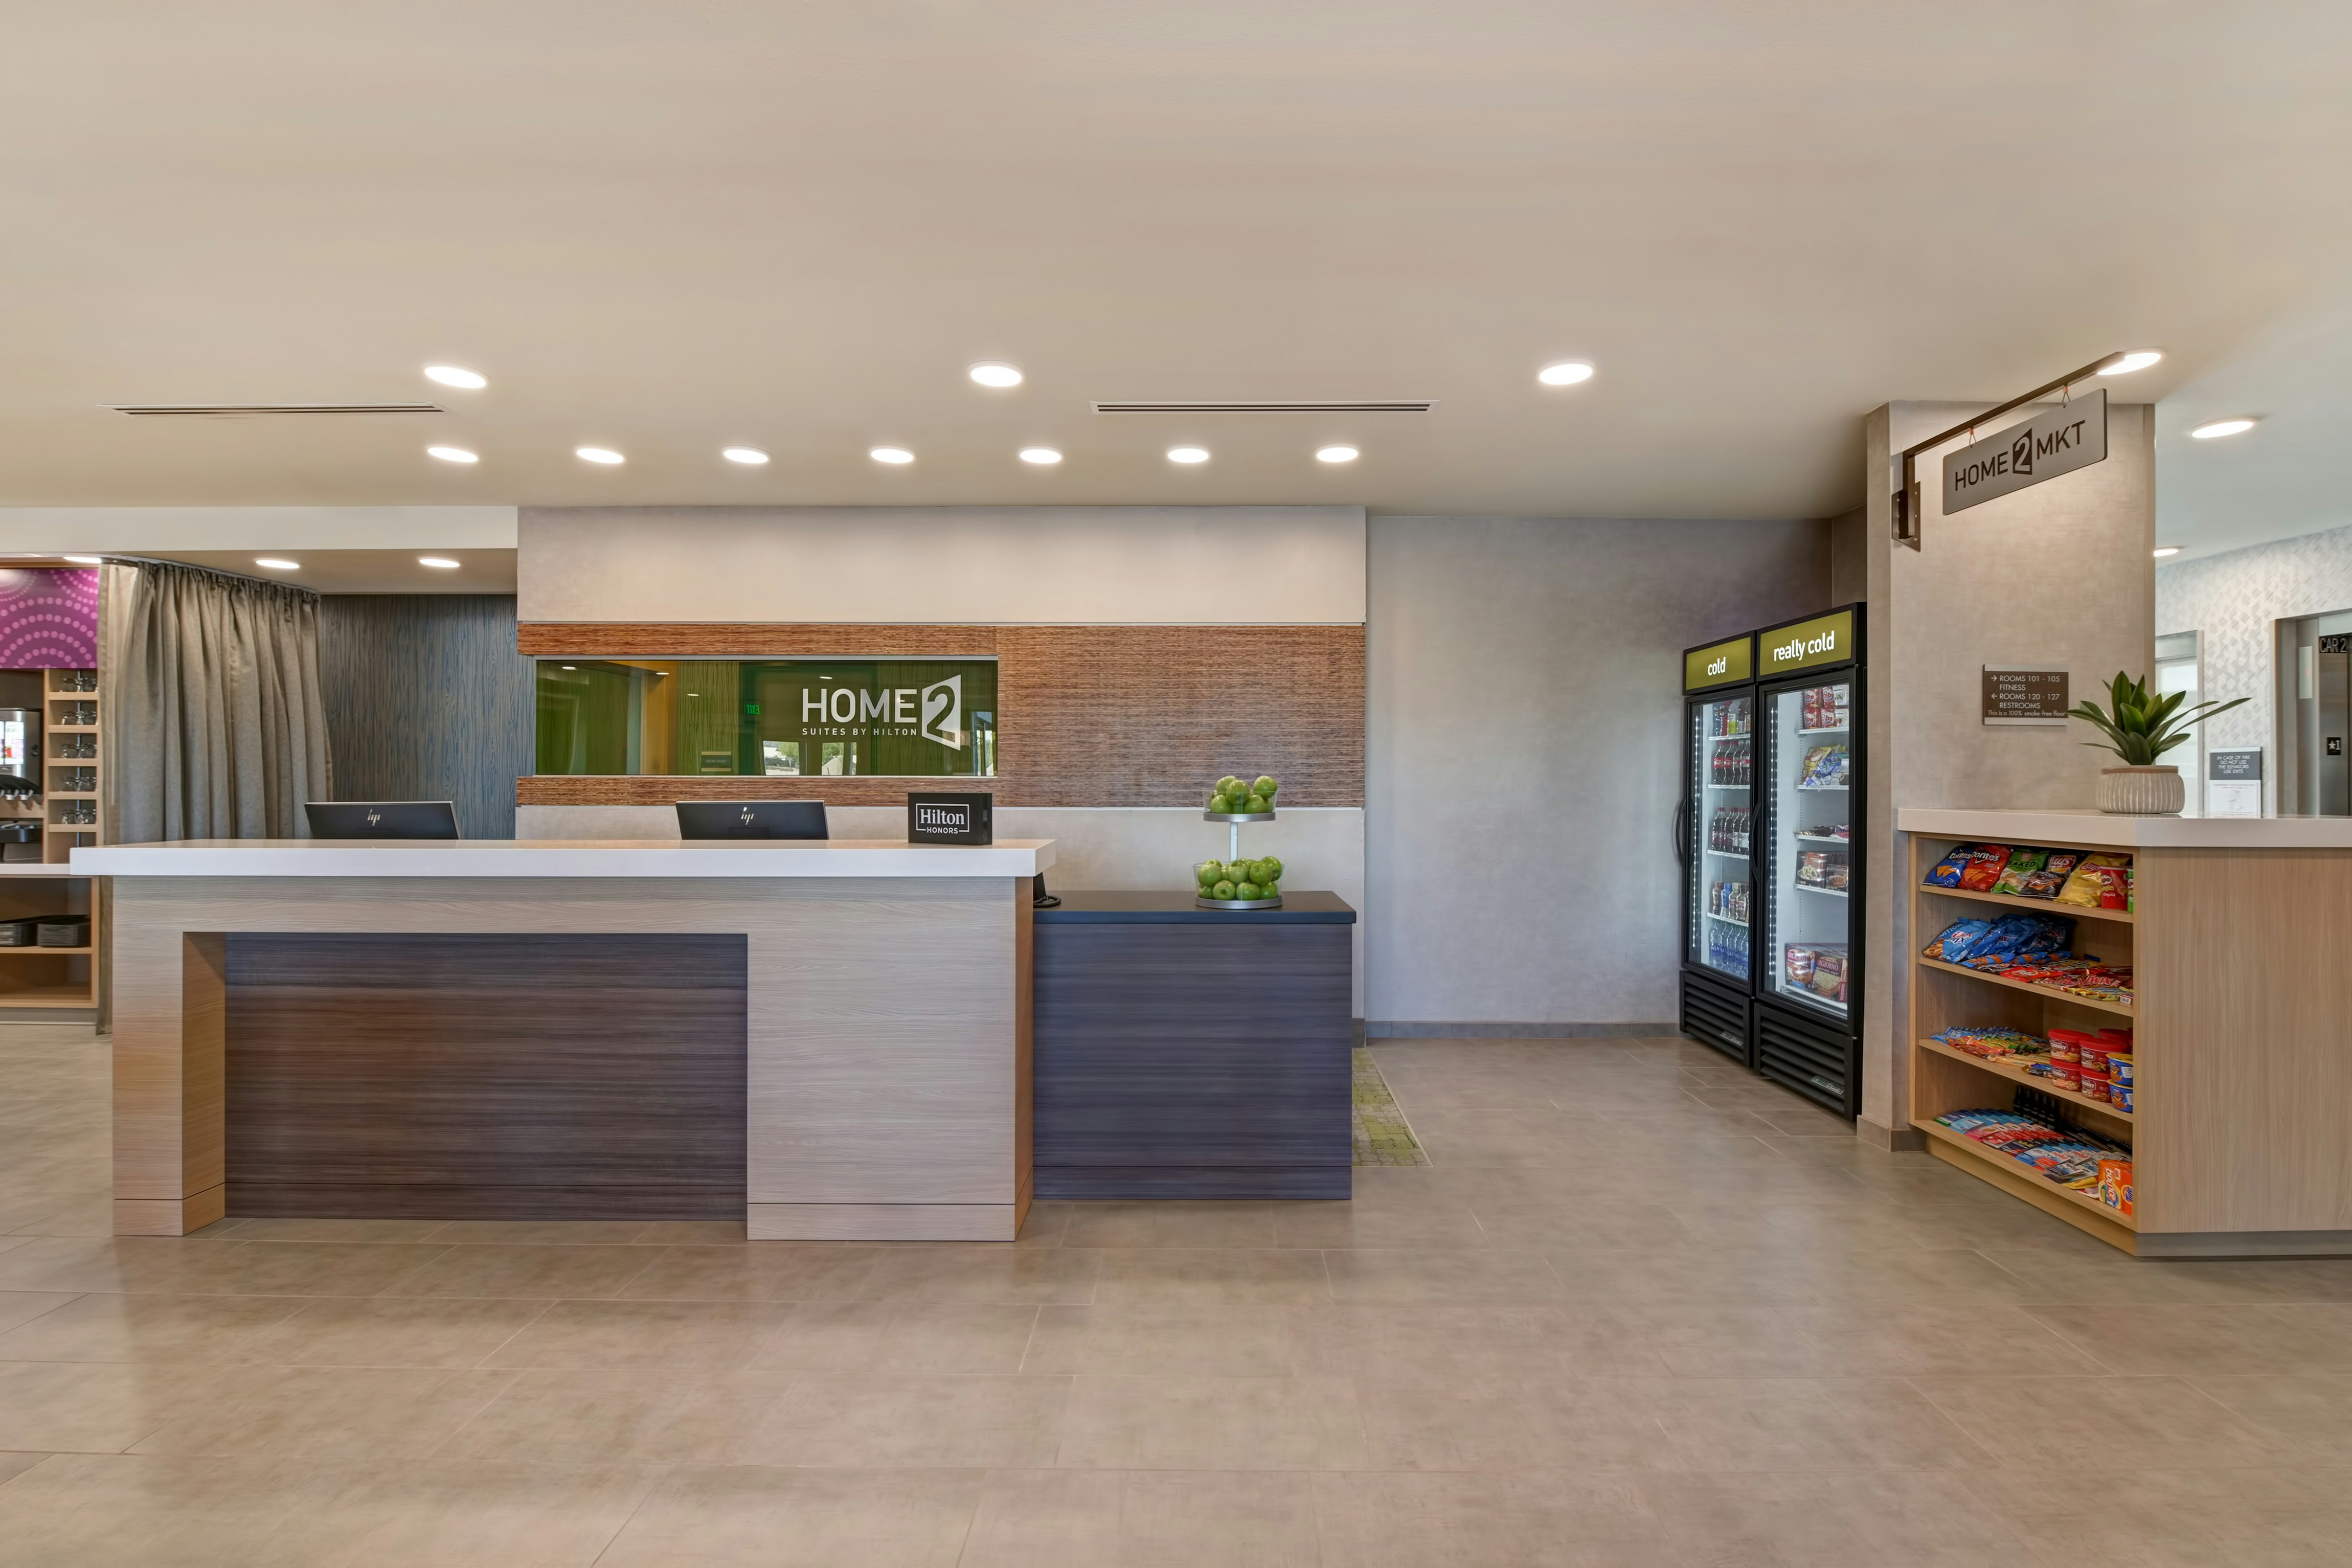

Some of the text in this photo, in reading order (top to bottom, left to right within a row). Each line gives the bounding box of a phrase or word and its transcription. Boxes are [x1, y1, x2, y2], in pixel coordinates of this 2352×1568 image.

[2037, 420, 2086, 460] MKT
[1774, 630, 1835, 662] really cold
[2320, 638, 2346, 653] CAR 2
[1708, 656, 1726, 676] cold
[920, 809, 965, 825] Hilton
[1971, 851, 2000, 862] Doritos
[2105, 1168, 2116, 1201] bounce
